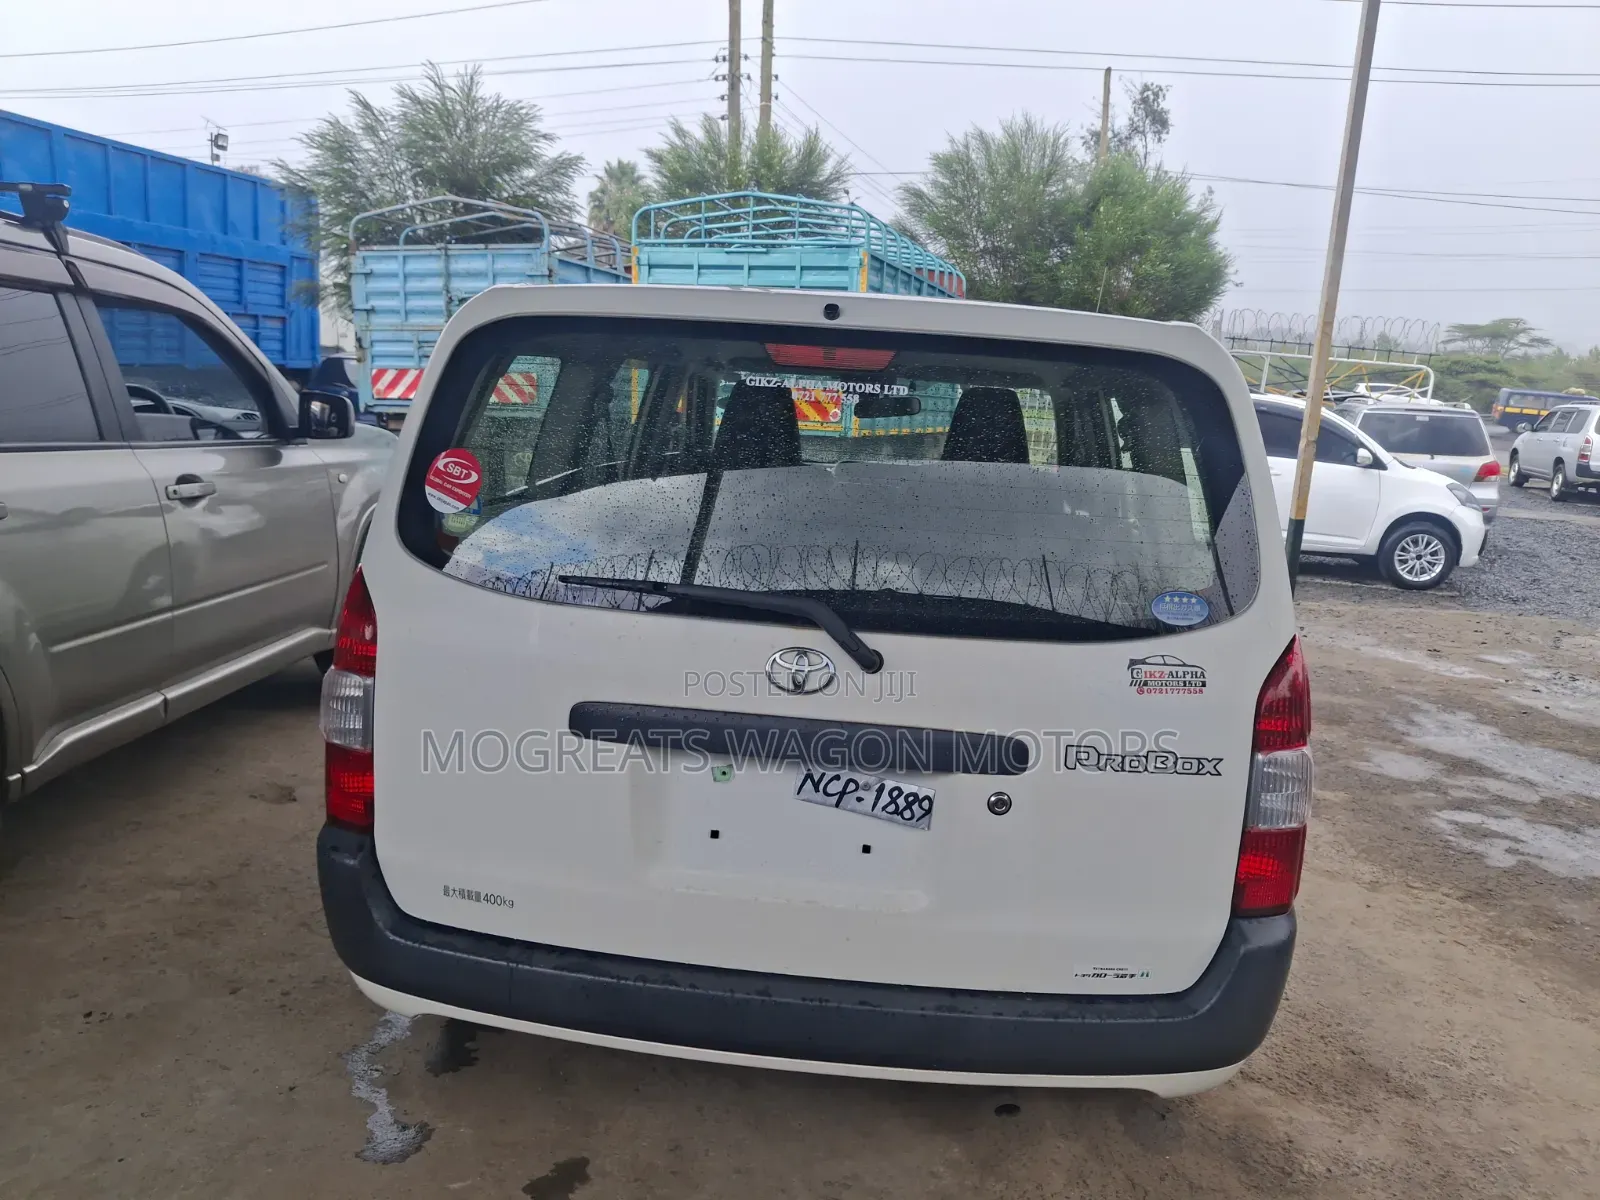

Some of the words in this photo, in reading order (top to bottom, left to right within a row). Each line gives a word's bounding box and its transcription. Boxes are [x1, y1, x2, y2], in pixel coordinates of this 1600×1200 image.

[745, 377, 822, 391] GIKZ-ALPHA
[827, 381, 881, 395] MOTORS
[883, 384, 908, 396] LTD
[792, 391, 815, 402] 0721
[818, 392, 838, 402] 777
[841, 394, 860, 404] 558
[446, 463, 468, 479] SBT
[1131, 668, 1206, 679] GIKZ-ALPHA
